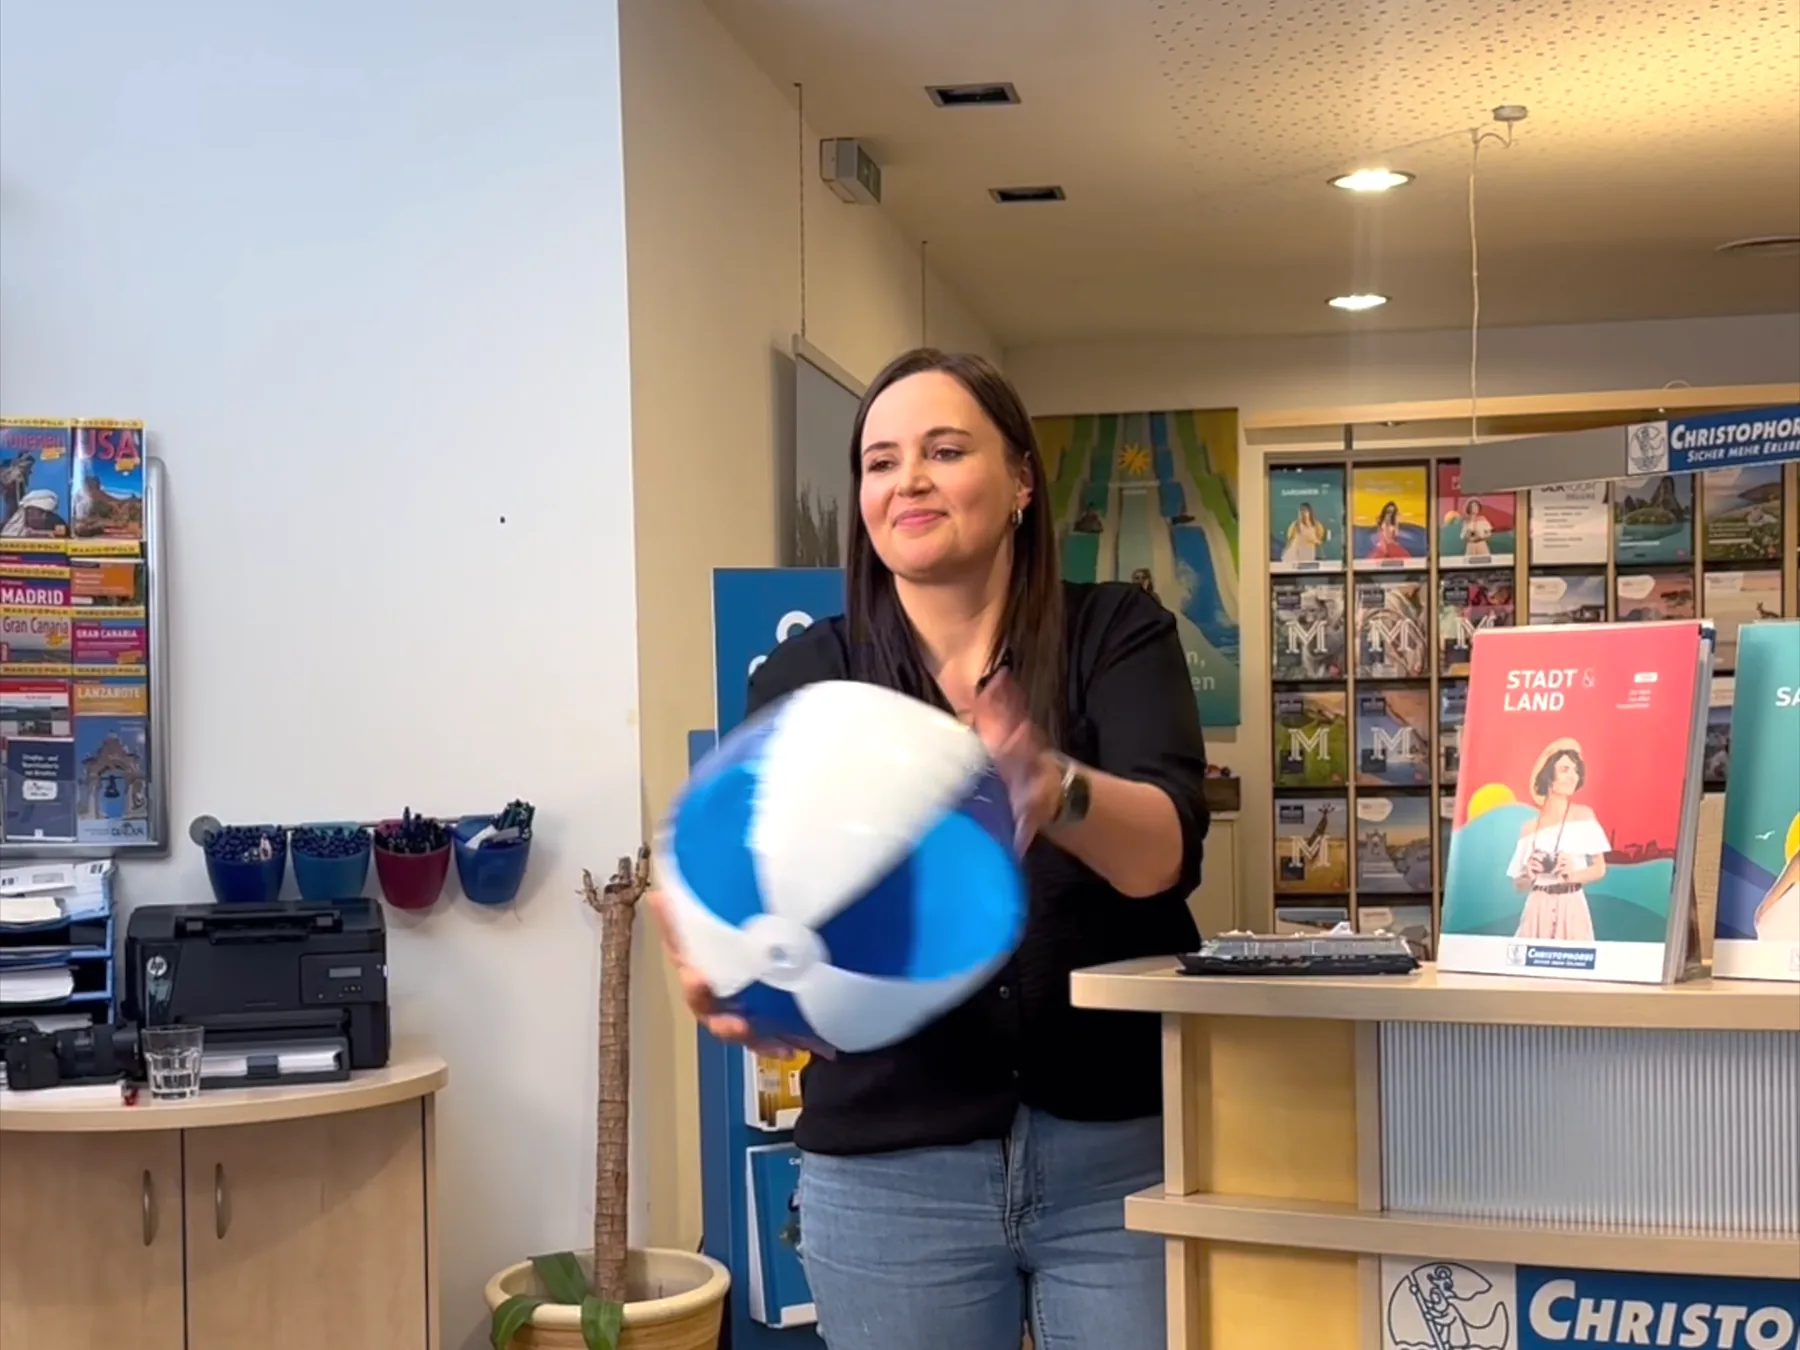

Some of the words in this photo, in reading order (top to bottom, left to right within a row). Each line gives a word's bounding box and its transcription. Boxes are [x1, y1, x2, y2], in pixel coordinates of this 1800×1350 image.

[79, 428, 139, 459] USA
[1687, 449, 1725, 463] SICHER
[1728, 445, 1760, 458] MEHR
[1, 588, 64, 605] MADRID
[3, 616, 28, 633] Gran
[30, 617, 69, 636] Canaria
[76, 629, 99, 638] GRAN
[101, 629, 138, 638] CANARIA
[1506, 668, 1578, 689] STADT
[78, 687, 140, 698] LANZAROTE
[1504, 691, 1564, 711] LAND
[1528, 1280, 1800, 1350] CHRISTO
